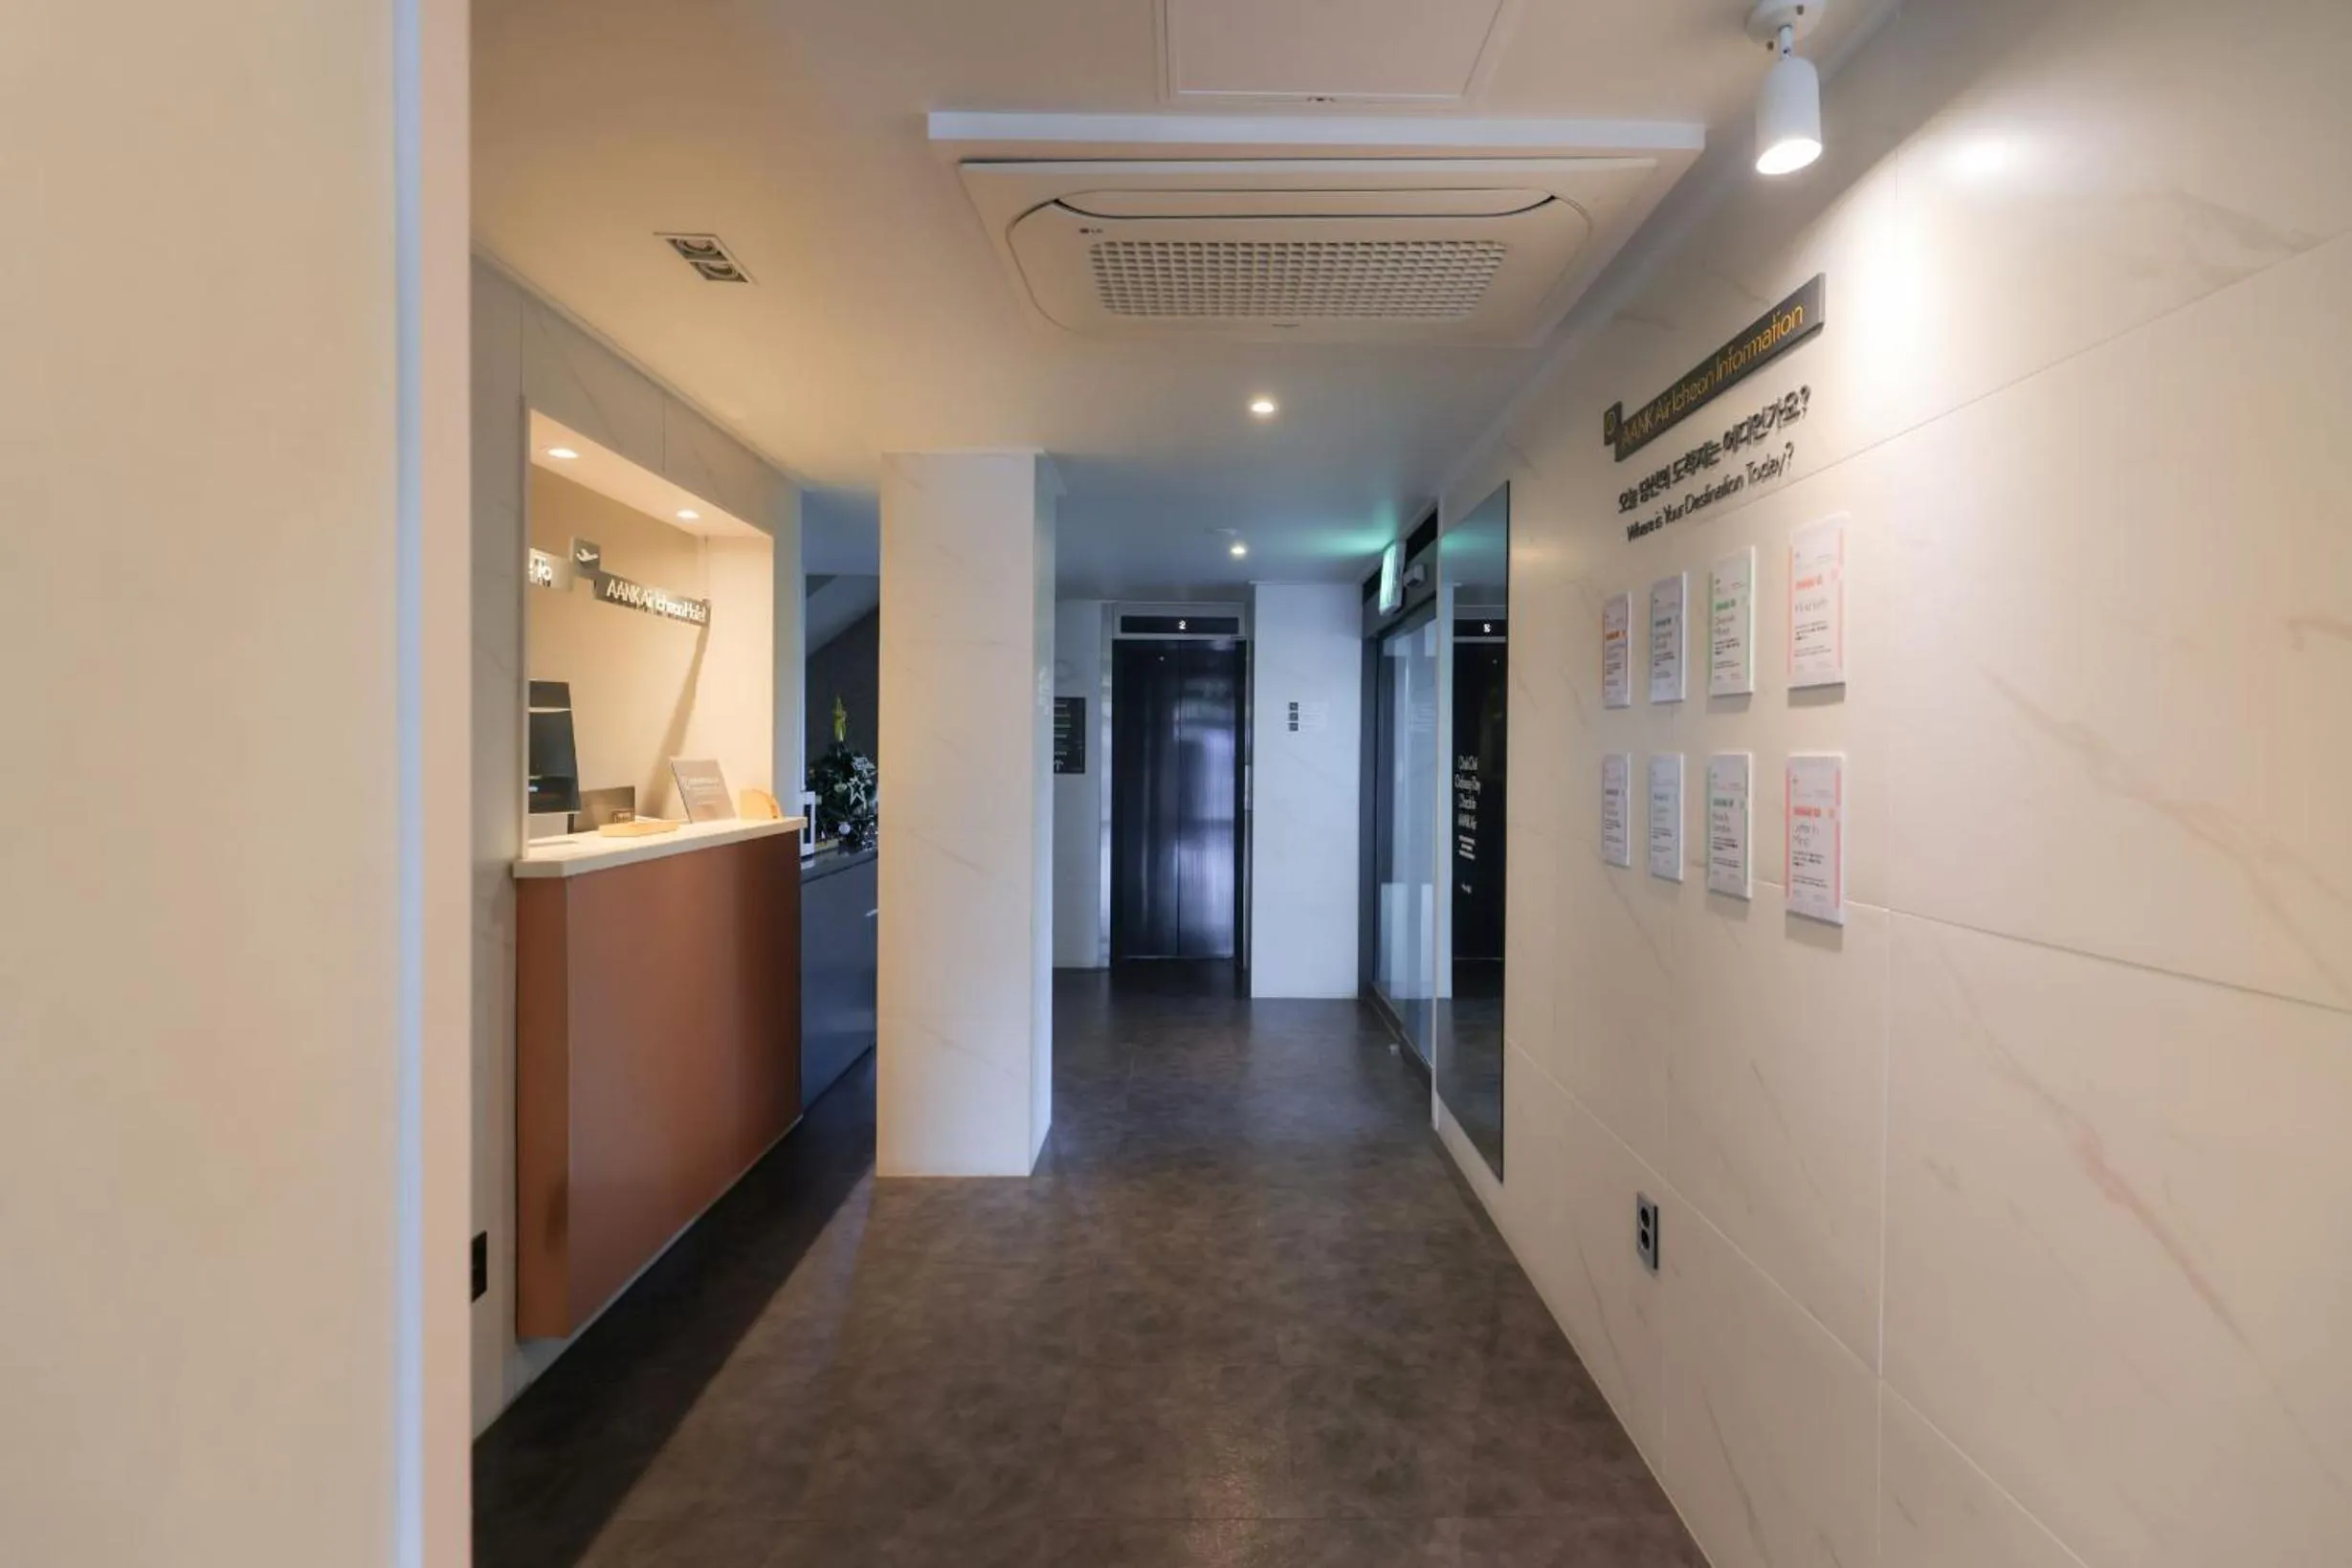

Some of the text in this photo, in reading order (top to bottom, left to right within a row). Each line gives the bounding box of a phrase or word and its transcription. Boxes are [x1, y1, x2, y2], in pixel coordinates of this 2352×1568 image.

[1717, 303, 1804, 383] Information
[1618, 487, 1638, 514] 오늘
[1627, 520, 1654, 542] Where
[1664, 503, 1685, 524] Your
[1685, 474, 1744, 515] Destination
[1745, 441, 1794, 484] Today?
[606, 578, 641, 605] AANK
[1178, 620, 1187, 629] 2
